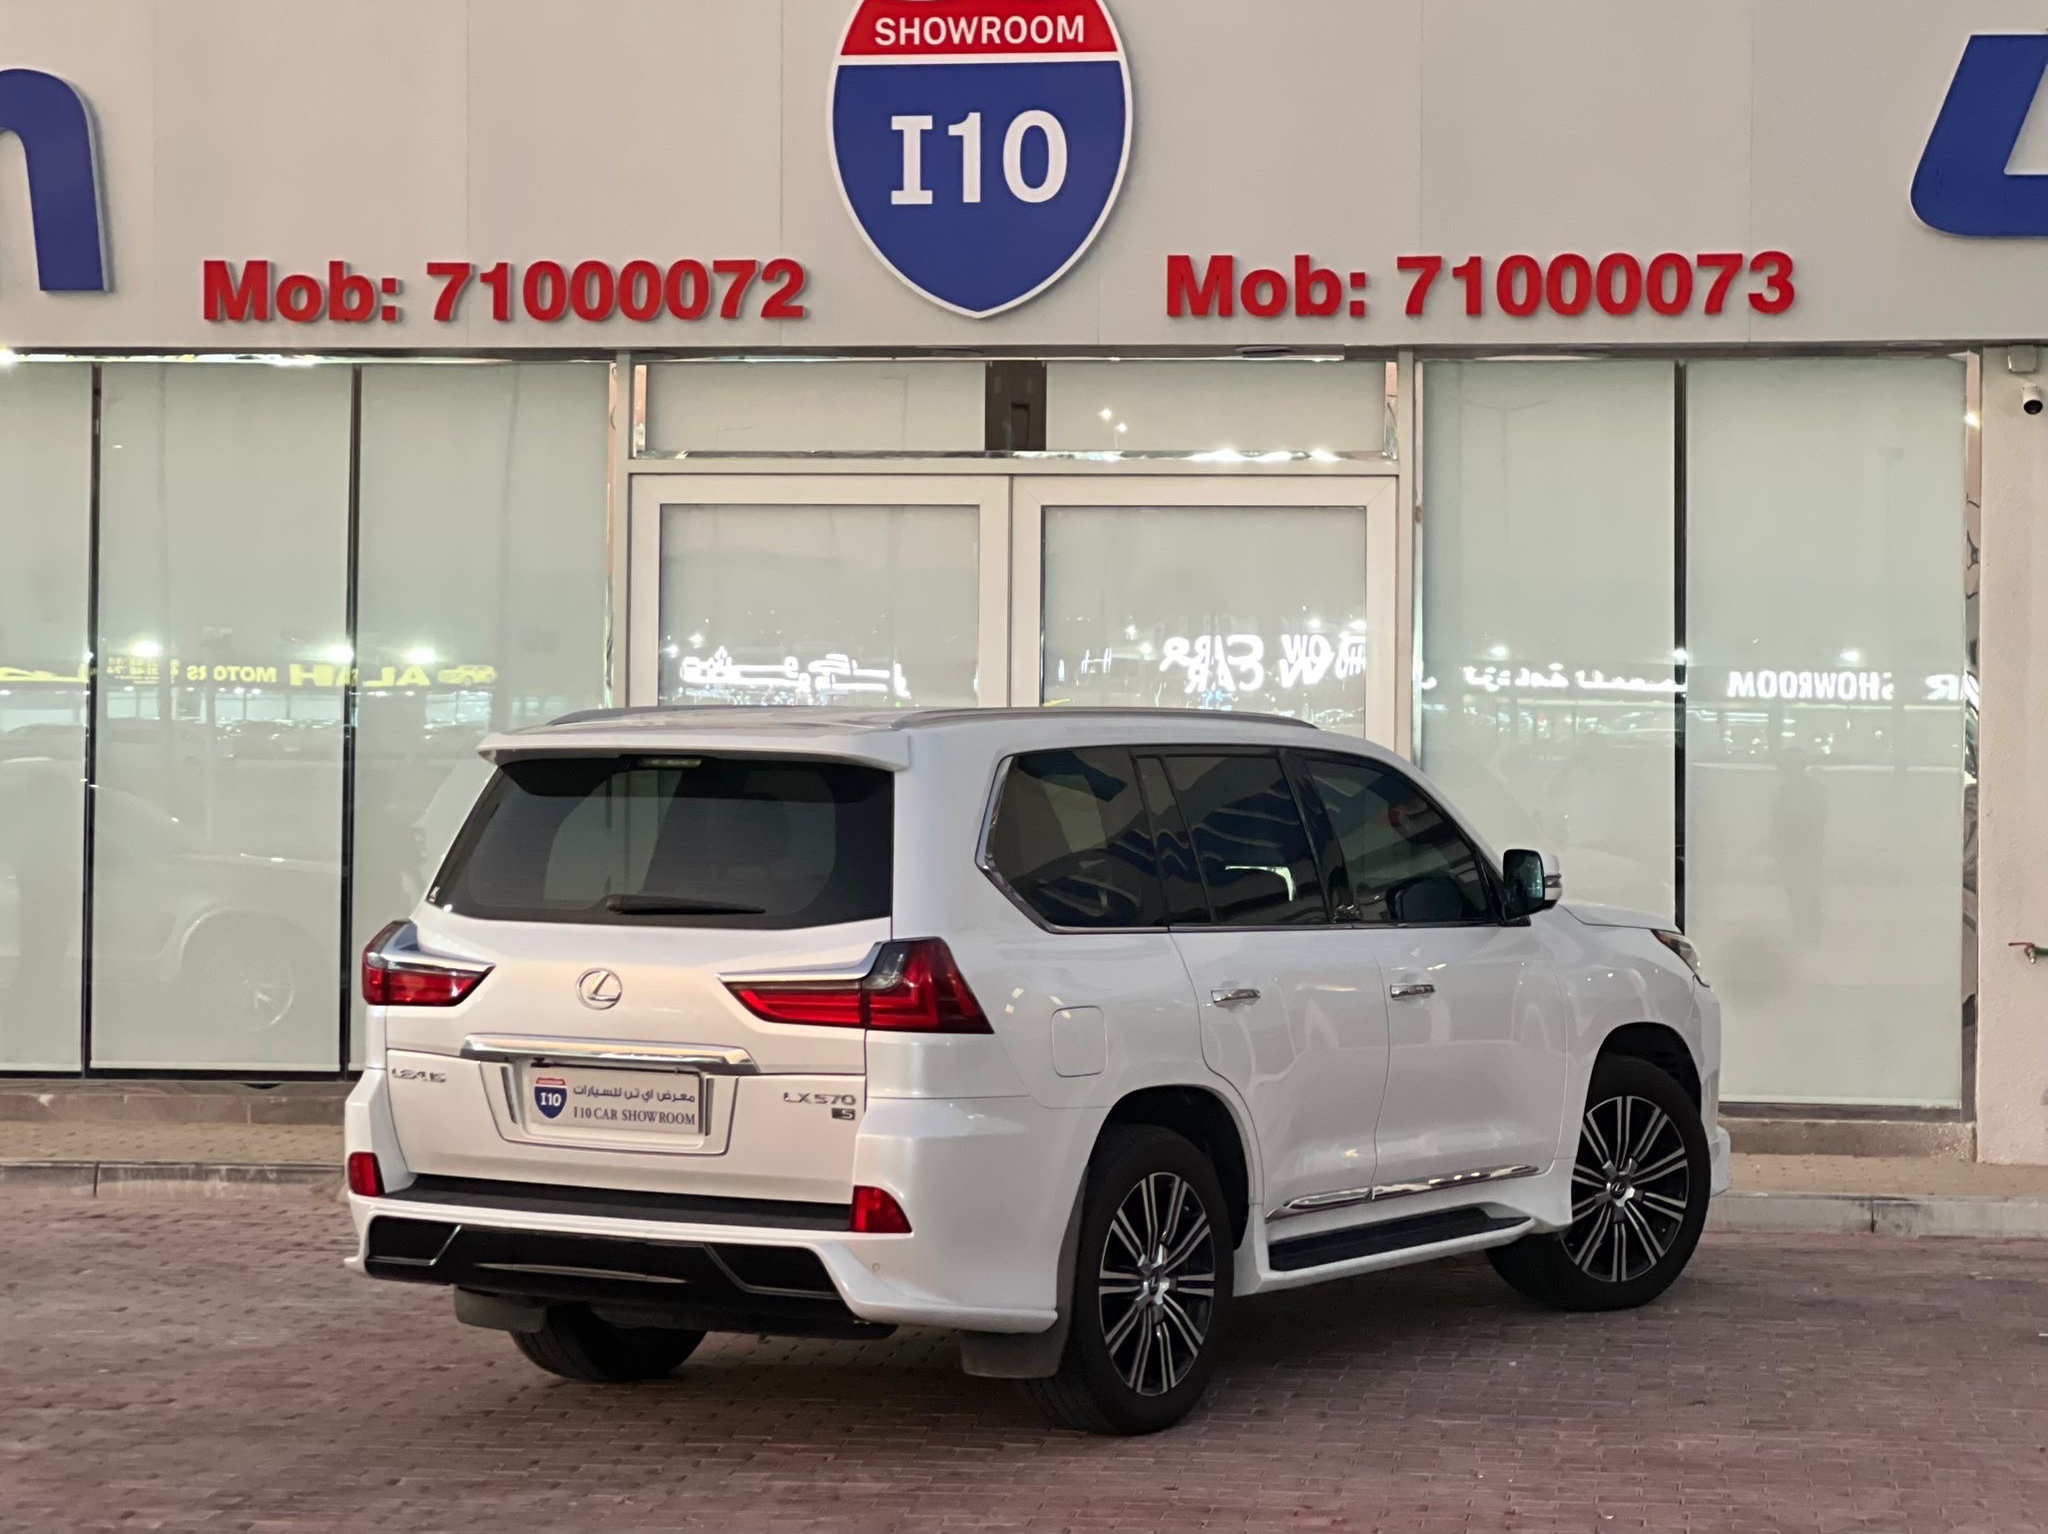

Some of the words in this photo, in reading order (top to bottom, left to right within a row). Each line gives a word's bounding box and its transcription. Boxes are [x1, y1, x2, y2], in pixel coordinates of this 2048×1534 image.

[874, 15, 1084, 46] SHOWROOM
[890, 109, 1068, 205] I10
[203, 259, 401, 323] Mob:
[426, 258, 807, 322] 71000072
[1166, 254, 1367, 317] Mob:
[1397, 250, 1796, 317] 71000073
[540, 1092, 562, 1107] I10
[573, 1085, 623, 1098] للسيارات
[656, 1091, 696, 1103] معرض
[593, 1107, 618, 1120] CAR
[621, 1109, 696, 1125] SHOWROOM
